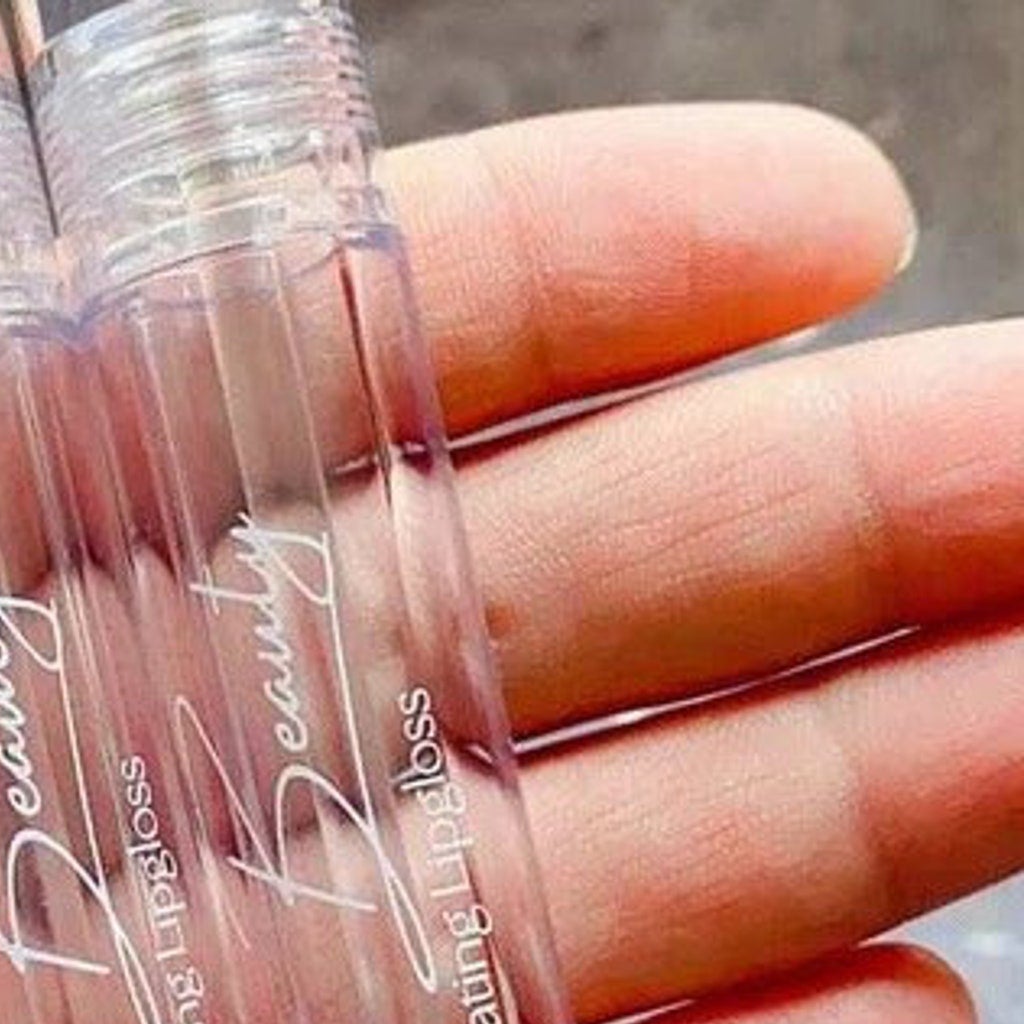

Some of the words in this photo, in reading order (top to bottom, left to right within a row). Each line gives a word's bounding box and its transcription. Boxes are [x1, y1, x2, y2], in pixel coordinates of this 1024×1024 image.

[121, 755, 187, 961] Lipgloss
[176, 511, 438, 994] Beauty
[400, 687, 474, 898] Lipgloss
